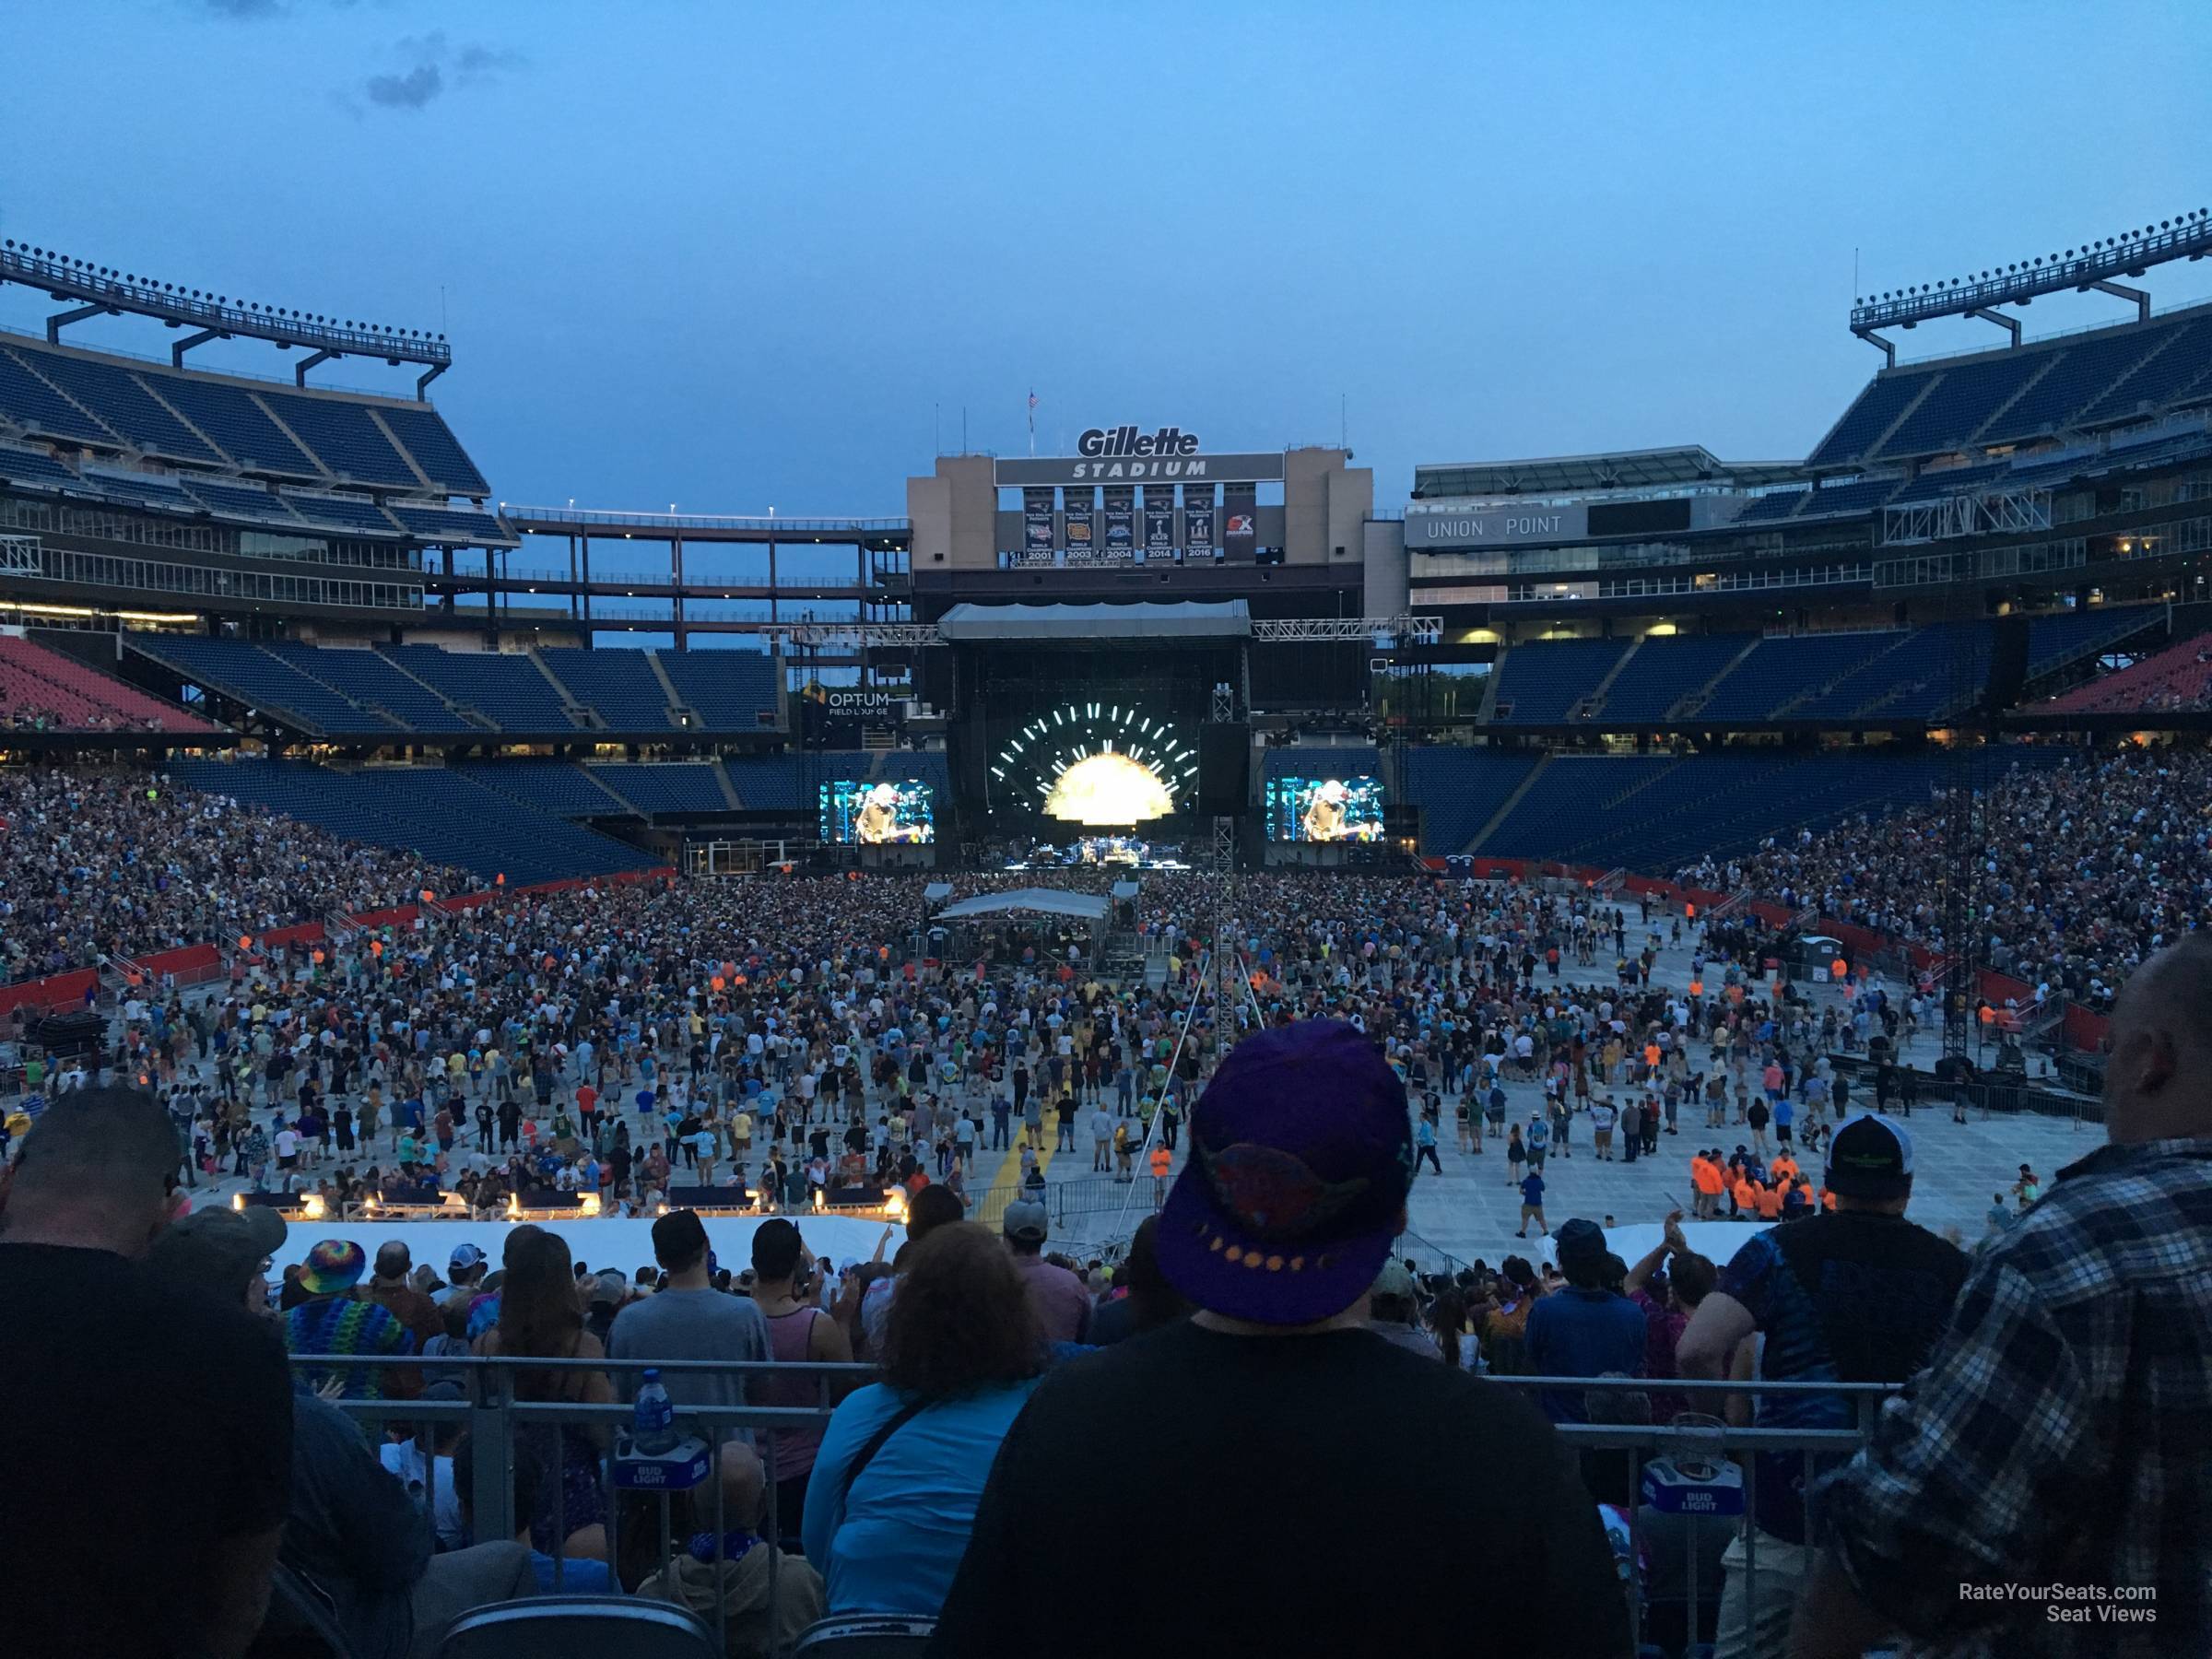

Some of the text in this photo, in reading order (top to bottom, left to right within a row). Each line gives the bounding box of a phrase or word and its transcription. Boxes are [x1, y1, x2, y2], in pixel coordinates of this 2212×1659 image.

[1077, 426, 1199, 458] Gillette
[1072, 461, 1206, 478] STADIUM
[1428, 515, 1562, 539] UNION POINT
[1029, 552, 1052, 560] 2001
[1107, 550, 1132, 559] 2004
[829, 692, 889, 707] OPTUM
[829, 708, 853, 716] FIELD
[637, 1465, 663, 1475] BUD
[633, 1476, 666, 1485] LIGHT
[1686, 1492, 1712, 1502] BUD
[1681, 1501, 1718, 1512] LIGHT
